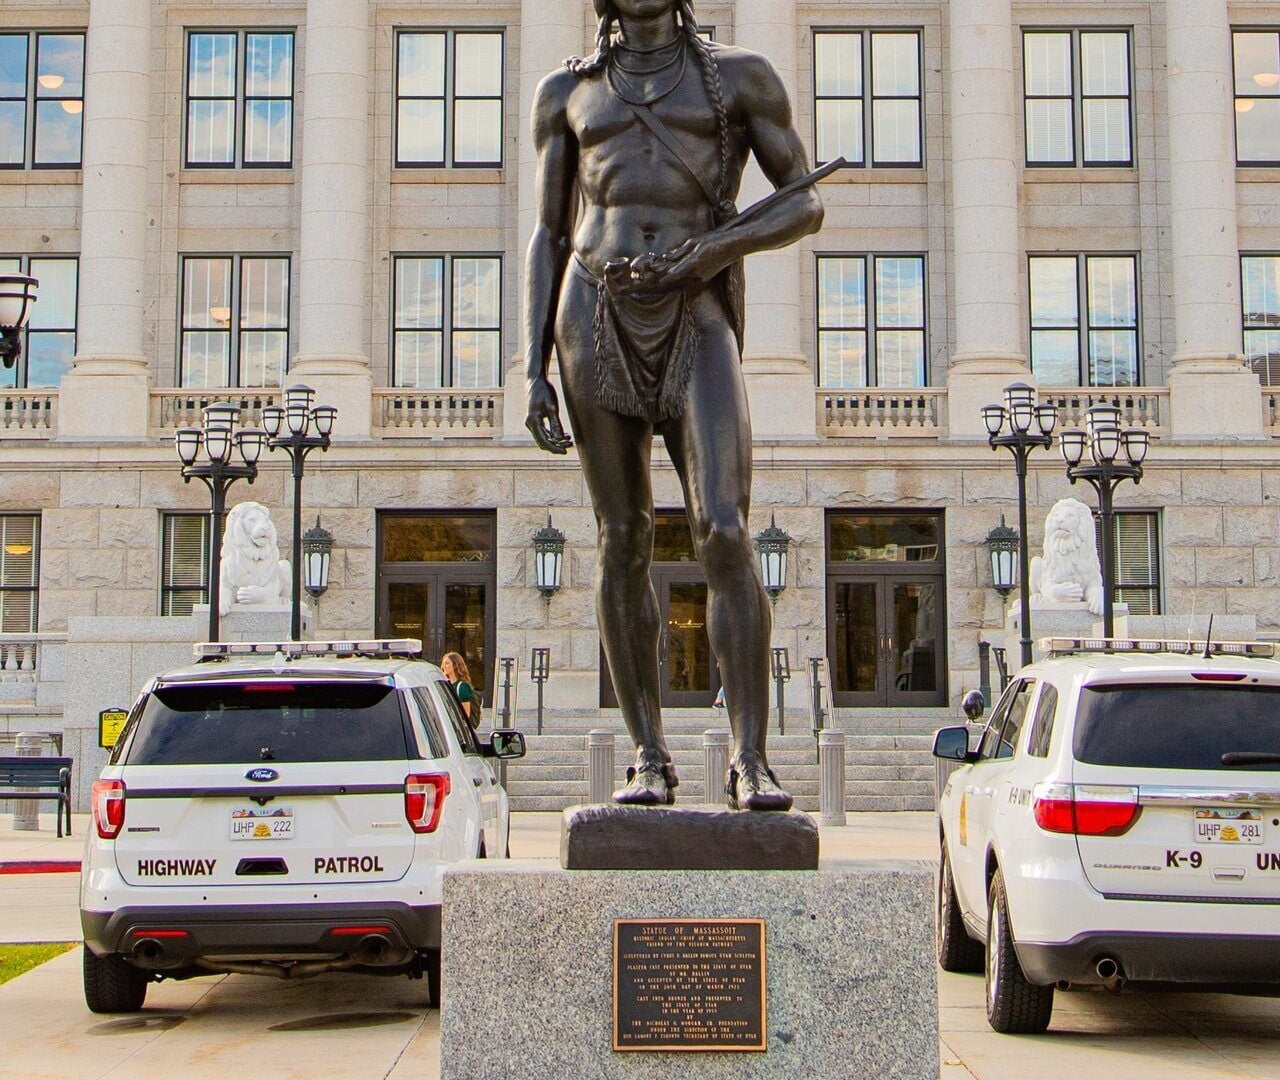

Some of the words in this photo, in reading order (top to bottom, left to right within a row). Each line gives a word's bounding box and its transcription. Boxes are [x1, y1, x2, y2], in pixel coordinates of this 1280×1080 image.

[252, 770, 272, 779] Ford
[234, 822, 254, 833] UHP
[274, 821, 291, 832] 222
[1198, 824, 1220, 836] UHP
[1242, 825, 1260, 837] 281
[1166, 850, 1202, 868] K-9
[138, 859, 217, 876] HIGHWAY
[315, 856, 384, 873] PATROL
[642, 927, 667, 935] STATUE
[675, 927, 683, 935] OF
[694, 927, 736, 935] MASSASSOIT
